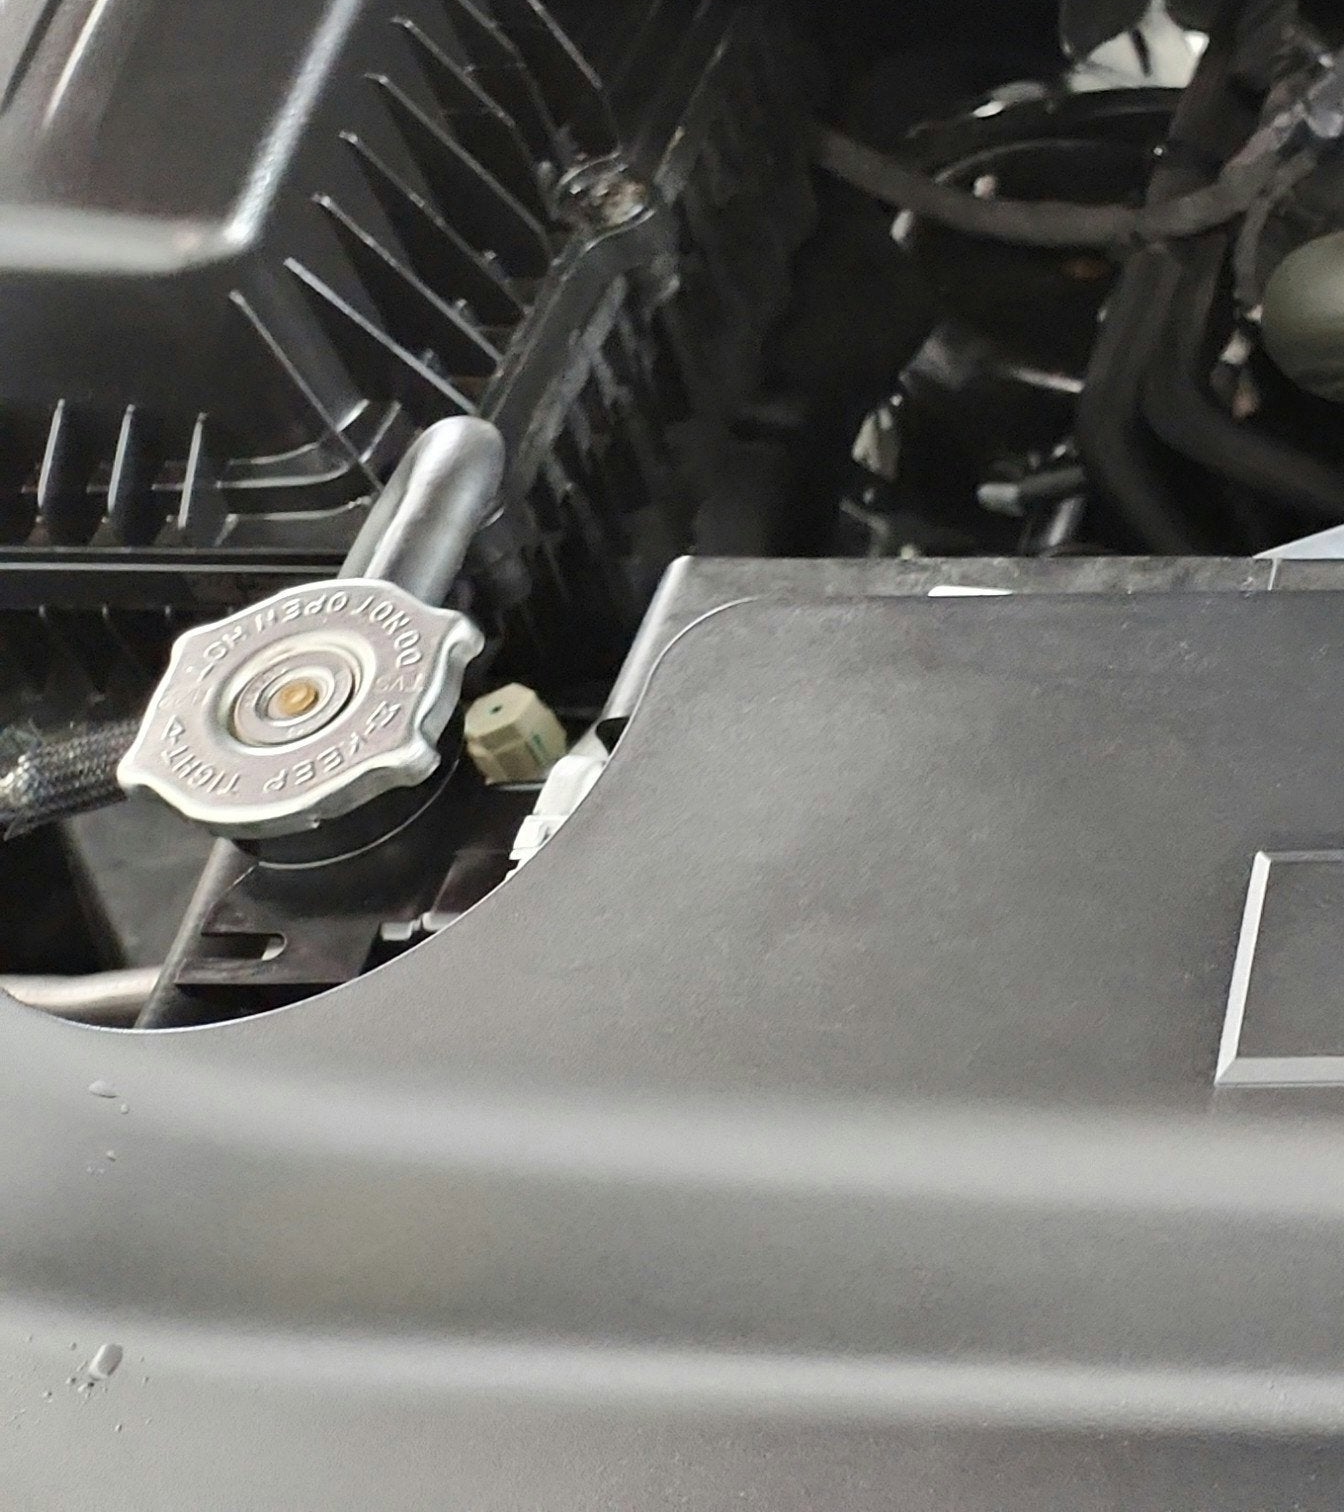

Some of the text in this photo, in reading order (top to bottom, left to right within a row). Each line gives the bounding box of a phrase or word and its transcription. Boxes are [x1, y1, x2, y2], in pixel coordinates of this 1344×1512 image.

[255, 591, 349, 633] OPEN
[160, 731, 369, 795] KEEP TIGHT
